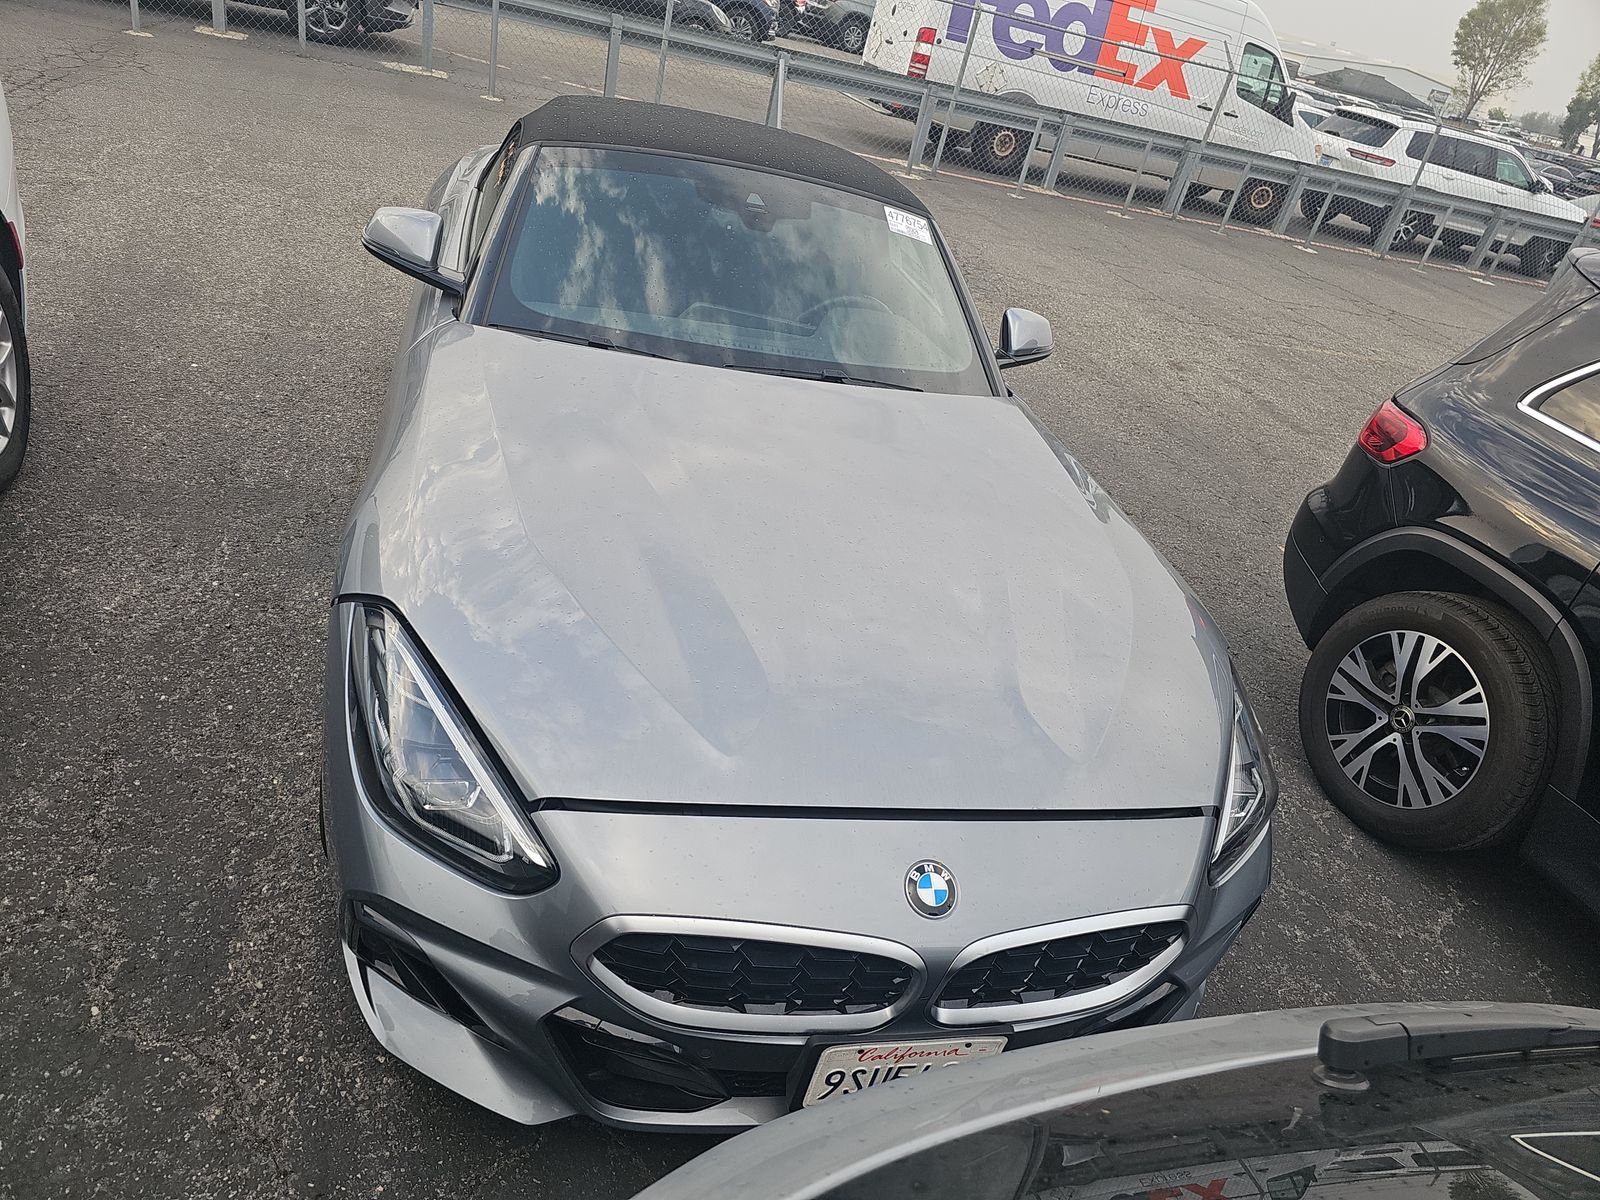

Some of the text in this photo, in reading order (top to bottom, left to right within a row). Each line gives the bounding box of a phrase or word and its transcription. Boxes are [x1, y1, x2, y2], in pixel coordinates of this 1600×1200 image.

[1086, 87, 1149, 117] Express
[887, 210, 930, 231] 4776754
[909, 863, 951, 882] BMW
[857, 1046, 968, 1064] California
